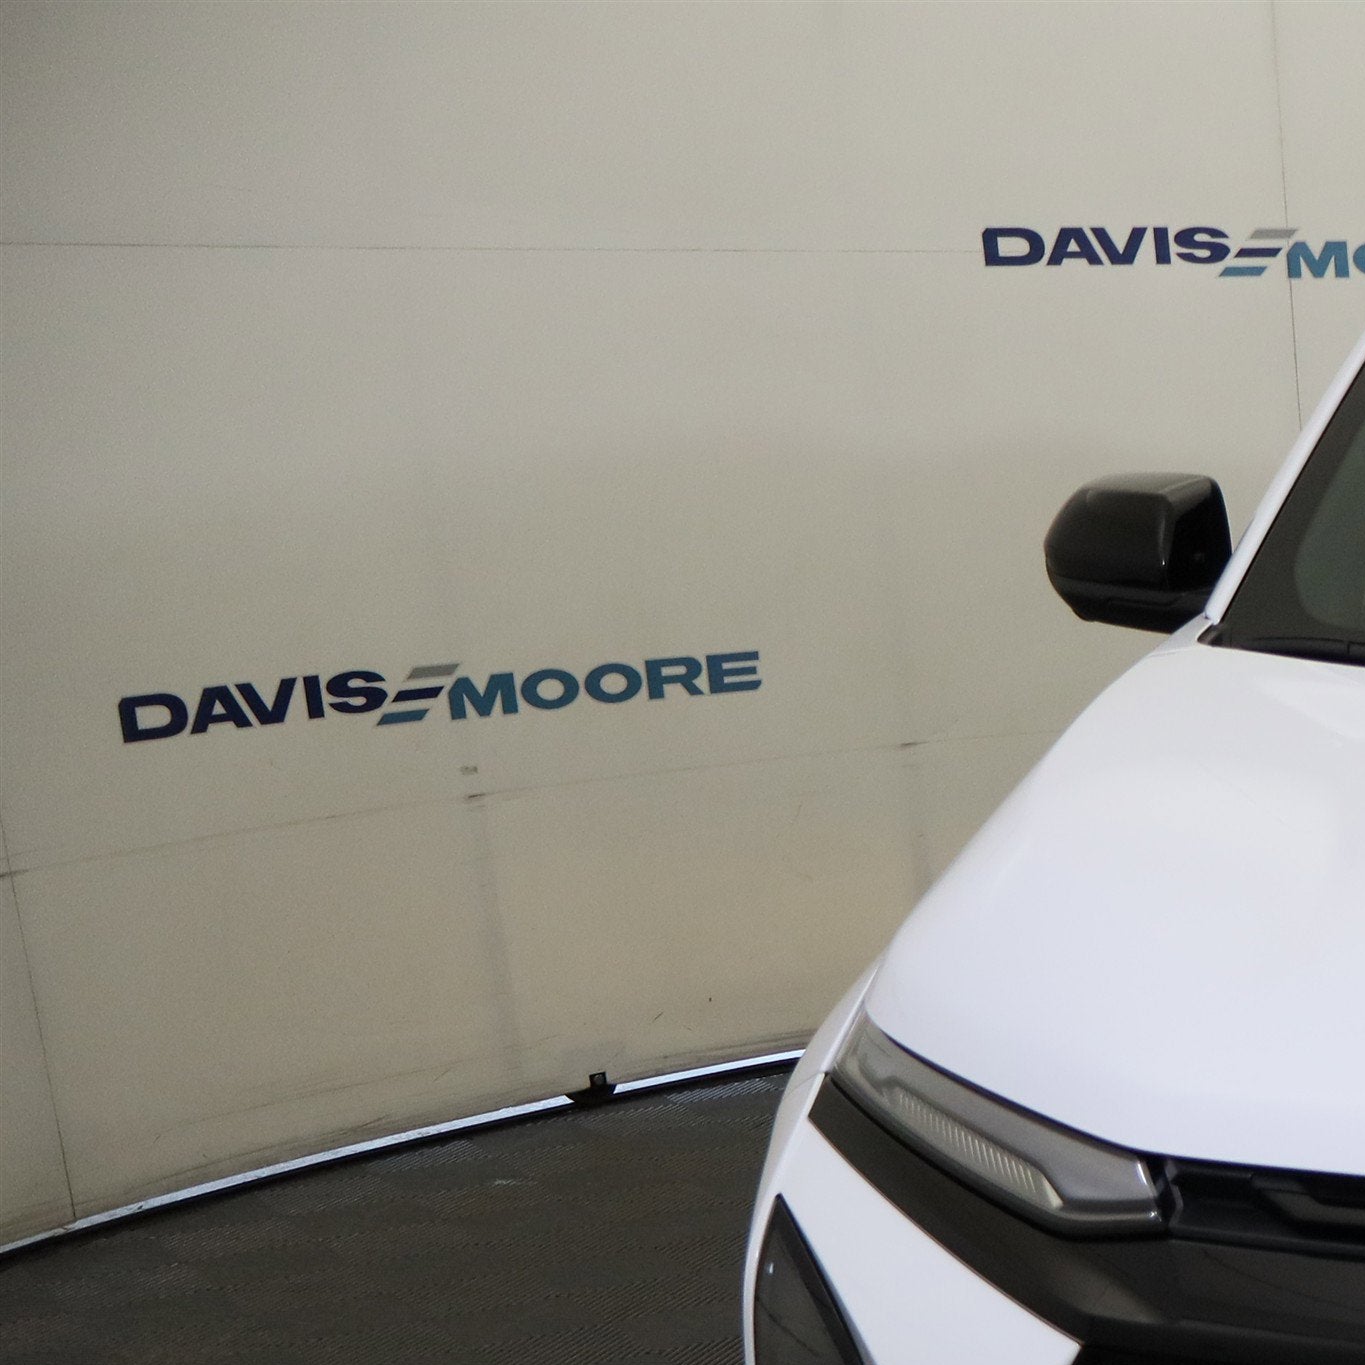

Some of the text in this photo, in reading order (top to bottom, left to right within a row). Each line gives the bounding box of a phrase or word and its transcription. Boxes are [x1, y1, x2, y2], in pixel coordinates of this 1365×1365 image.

[981, 226, 1231, 268] DAVIS
[116, 650, 764, 745] DAVIS MOORE
